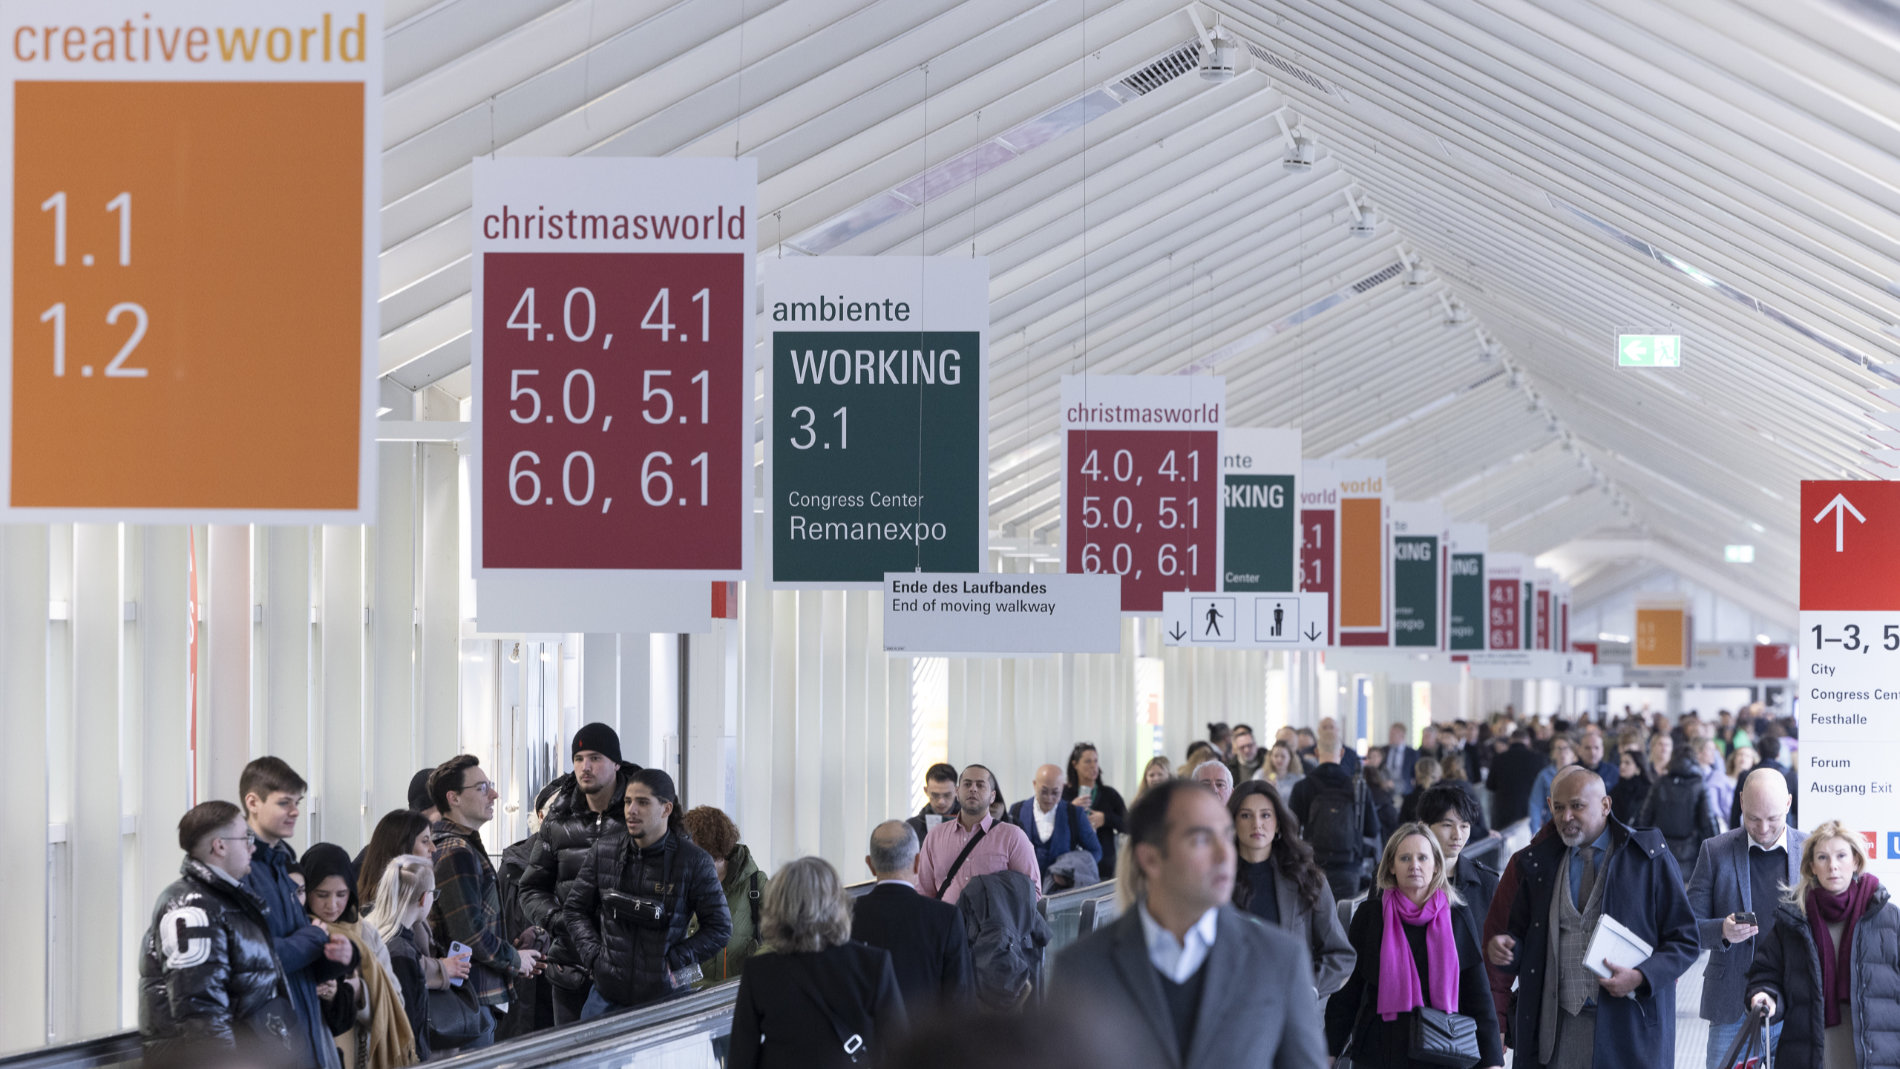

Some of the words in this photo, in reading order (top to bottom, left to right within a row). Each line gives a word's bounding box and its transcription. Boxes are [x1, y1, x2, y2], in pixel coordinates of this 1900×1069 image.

[13, 12, 366, 63] creativeworld
[41, 191, 132, 267] 1.1
[483, 205, 745, 241] christmasworld
[506, 287, 614, 350] 4.0,
[640, 287, 710, 343] 4.1
[772, 295, 911, 322] ambiente
[40, 302, 149, 378] 1.2
[790, 349, 961, 386] WORKING
[508, 369, 613, 432] 5.0,
[640, 369, 709, 425] 5.1
[1067, 402, 1219, 424] christmasworld
[789, 405, 848, 450] 3.1
[507, 451, 613, 514] 6.0,
[639, 450, 709, 507] 6.1
[1080, 449, 1143, 487] 4.0,
[1157, 449, 1199, 482] 4.1
[788, 491, 865, 510] Congress
[870, 491, 924, 507] Center
[1082, 496, 1142, 534] 5.0,
[1158, 497, 1198, 529] 5.1
[790, 515, 947, 547] Remanexpo
[1081, 543, 1142, 580] 6.0,
[1157, 543, 1198, 576] 6.1
[1225, 571, 1260, 584] Center
[892, 580, 928, 594] Ende
[933, 580, 958, 594] des
[963, 580, 1047, 594] Laufbandes
[892, 598, 918, 612] End
[922, 598, 938, 612] of
[940, 599, 991, 616] moving
[995, 598, 1056, 616] walkway
[1811, 663, 1836, 677] City
[1811, 688, 1870, 702] Congress
[1811, 713, 1867, 725] Festhalle
[1811, 756, 1851, 768] Forum
[1810, 782, 1866, 795] Ausgang
[1871, 781, 1893, 793] Exit
